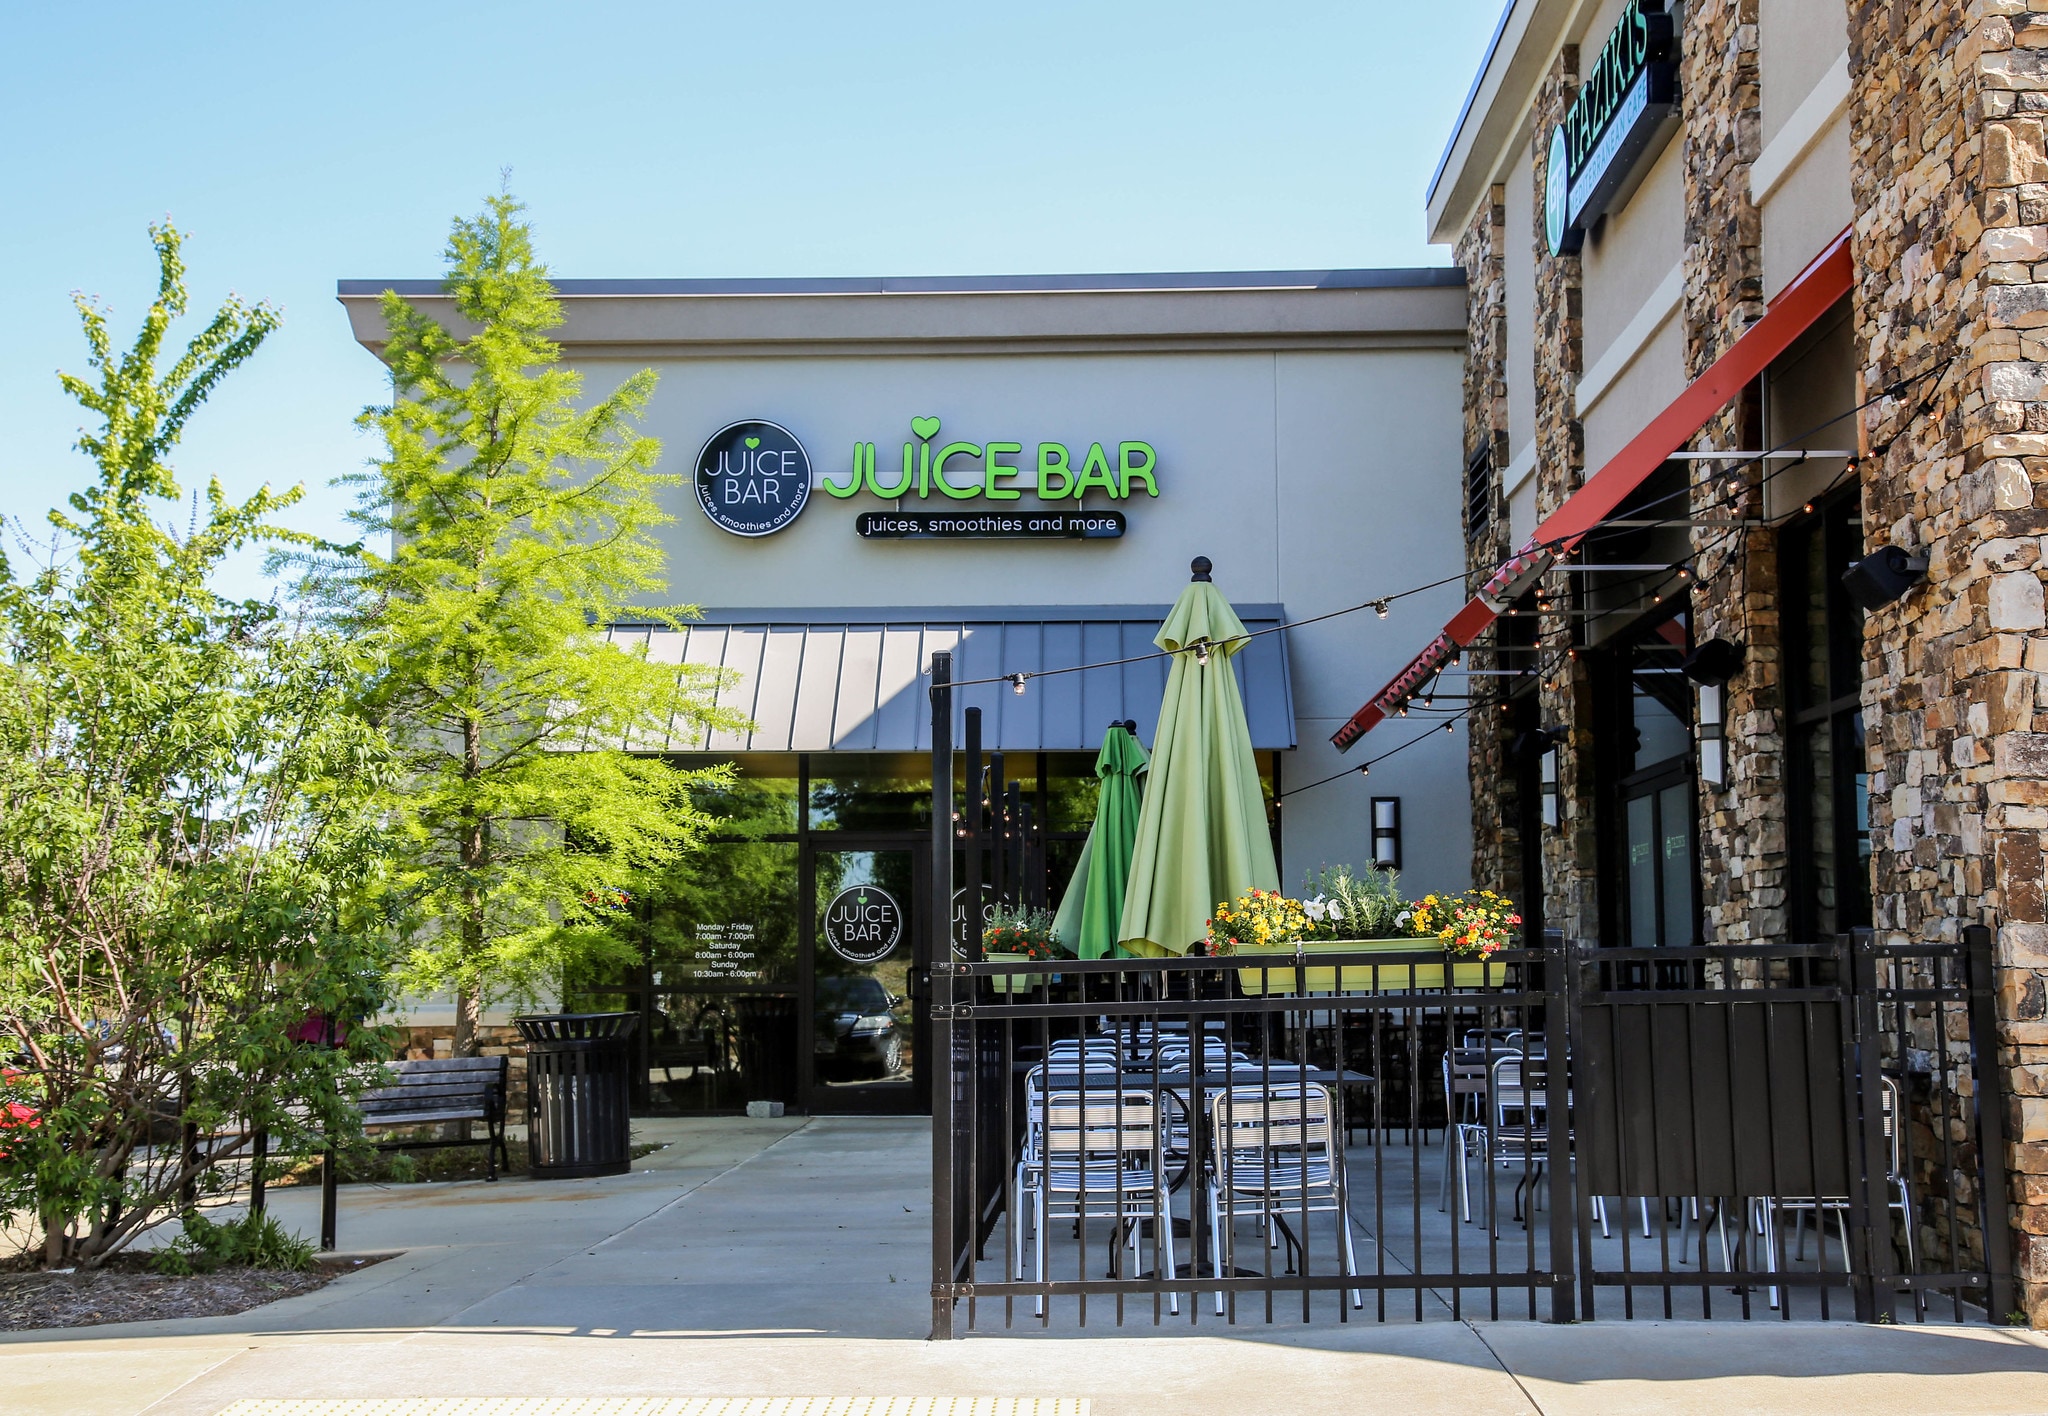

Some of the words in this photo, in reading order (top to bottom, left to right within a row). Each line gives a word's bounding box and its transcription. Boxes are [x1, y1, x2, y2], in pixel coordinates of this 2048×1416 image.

[1570, 112, 1625, 215] MEDITERRANEAN
[1627, 77, 1647, 124] CAFE
[705, 450, 797, 477] JUICE
[822, 441, 1022, 501] JUICE
[1037, 440, 1161, 501] BAR
[724, 478, 780, 505] BAR
[699, 483, 718, 516] juices,
[719, 514, 772, 531] smoothies
[773, 507, 791, 524] and
[790, 482, 805, 509] more
[865, 517, 922, 535] juices,
[928, 516, 1022, 532] smoothies
[1028, 515, 1063, 532] and
[1068, 517, 1117, 531] more
[831, 905, 892, 923] JUICE
[695, 932, 722, 940] 7:00am
[728, 932, 755, 941] 7:00pm
[696, 923, 725, 932] Monday
[731, 923, 754, 932] Friday
[844, 923, 881, 941] BAR
[708, 942, 741, 951] Saturday
[841, 947, 876, 959] smoothies
[876, 943, 889, 955] and
[887, 926, 898, 944] more
[694, 951, 722, 959] 8:00am
[727, 951, 755, 960] 6:00pm
[711, 960, 739, 970] Sunday
[693, 970, 724, 978] 10:30am
[729, 970, 757, 979] 6:00pm
